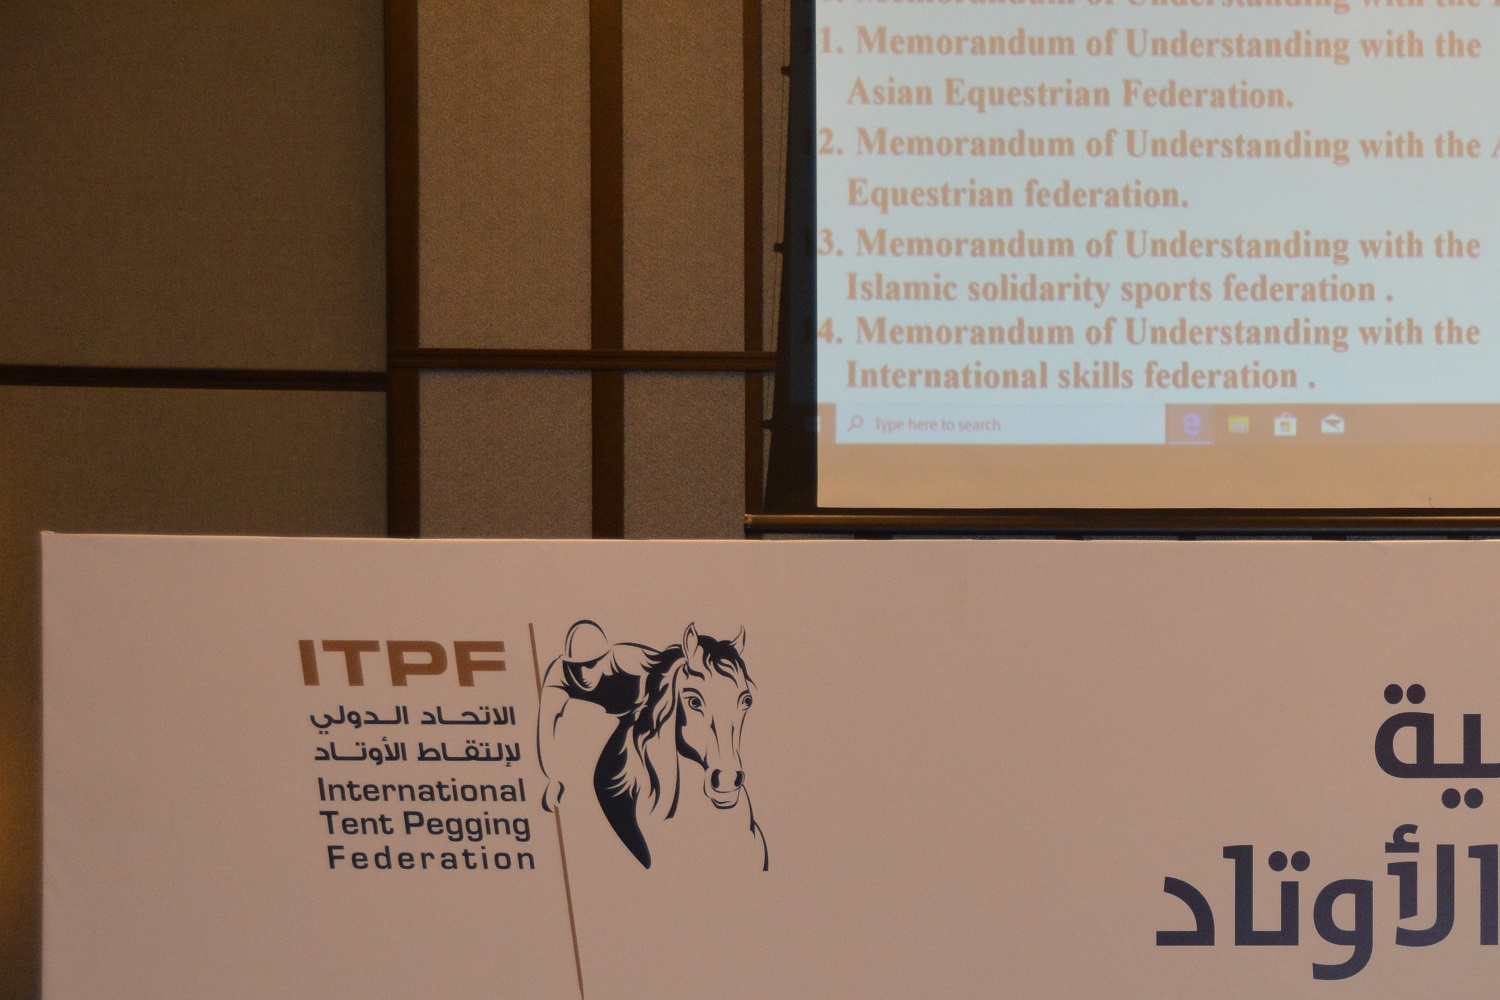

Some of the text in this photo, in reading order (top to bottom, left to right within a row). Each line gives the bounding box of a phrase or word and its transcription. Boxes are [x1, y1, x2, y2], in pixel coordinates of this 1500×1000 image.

[856, 24, 1076, 56] Memorandum
[1084, 26, 1118, 57] of
[1125, 26, 1351, 66] Understanding
[1359, 29, 1425, 58] with
[1434, 30, 1482, 59] the
[849, 76, 1294, 113] Asian Equestrian Federation.
[856, 126, 1076, 157] Memorandum
[1084, 127, 1118, 157] of
[1125, 127, 1351, 166] Understanding
[1358, 129, 1425, 158] with
[1434, 130, 1481, 159] the
[847, 177, 1188, 214] Equestrian federation.
[855, 226, 1075, 257] Memorandum
[1084, 227, 1118, 257] of
[1125, 228, 1350, 265] Understanding
[1358, 229, 1424, 258] with
[1433, 229, 1481, 258] the
[846, 271, 956, 301] Islamic
[966, 272, 1109, 308] solidarity
[1120, 277, 1213, 309] sports
[1222, 271, 1376, 302] federation
[855, 315, 1075, 345] Memorandum
[1084, 315, 1117, 345] of
[1124, 315, 1350, 352] Understanding
[1358, 316, 1424, 345] with
[1433, 316, 1480, 345] the
[846, 358, 1048, 389] International
[1057, 359, 1134, 389] skills
[1144, 359, 1298, 389] federation
[874, 416, 1001, 433] Type here to search
[298, 640, 506, 687] ITPF
[310, 706, 515, 734] الاتحاد الدولي
[315, 737, 520, 767] لإلتقاط الأوتاد
[318, 777, 525, 802] International
[319, 811, 530, 842] Tent Pegging
[327, 845, 535, 869] Federation
[1156, 824, 1498, 980] الأوتاد
